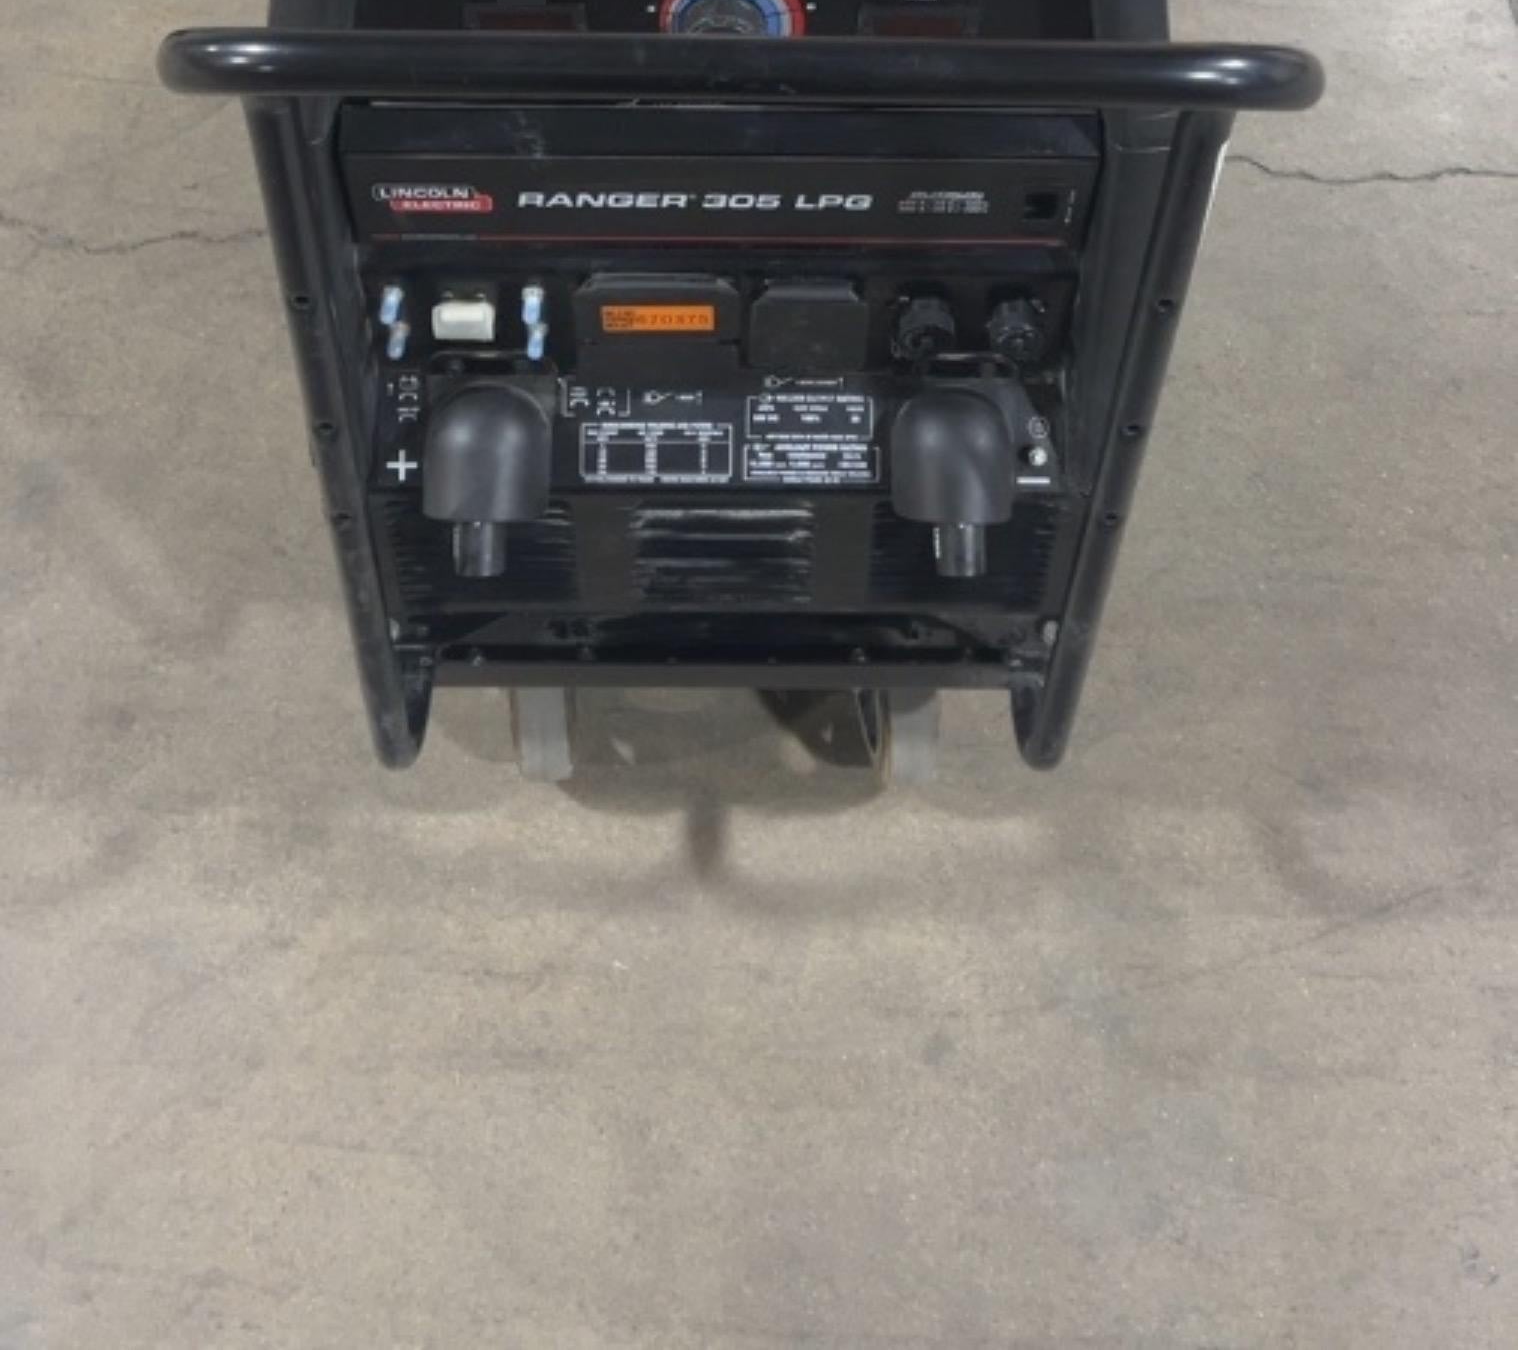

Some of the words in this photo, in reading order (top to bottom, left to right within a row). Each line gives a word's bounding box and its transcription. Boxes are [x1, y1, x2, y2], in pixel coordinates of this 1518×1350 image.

[379, 187, 470, 199] LINCOLN
[401, 200, 481, 211] ELECTRIC
[701, 193, 782, 210] 305
[794, 193, 874, 211] LPG
